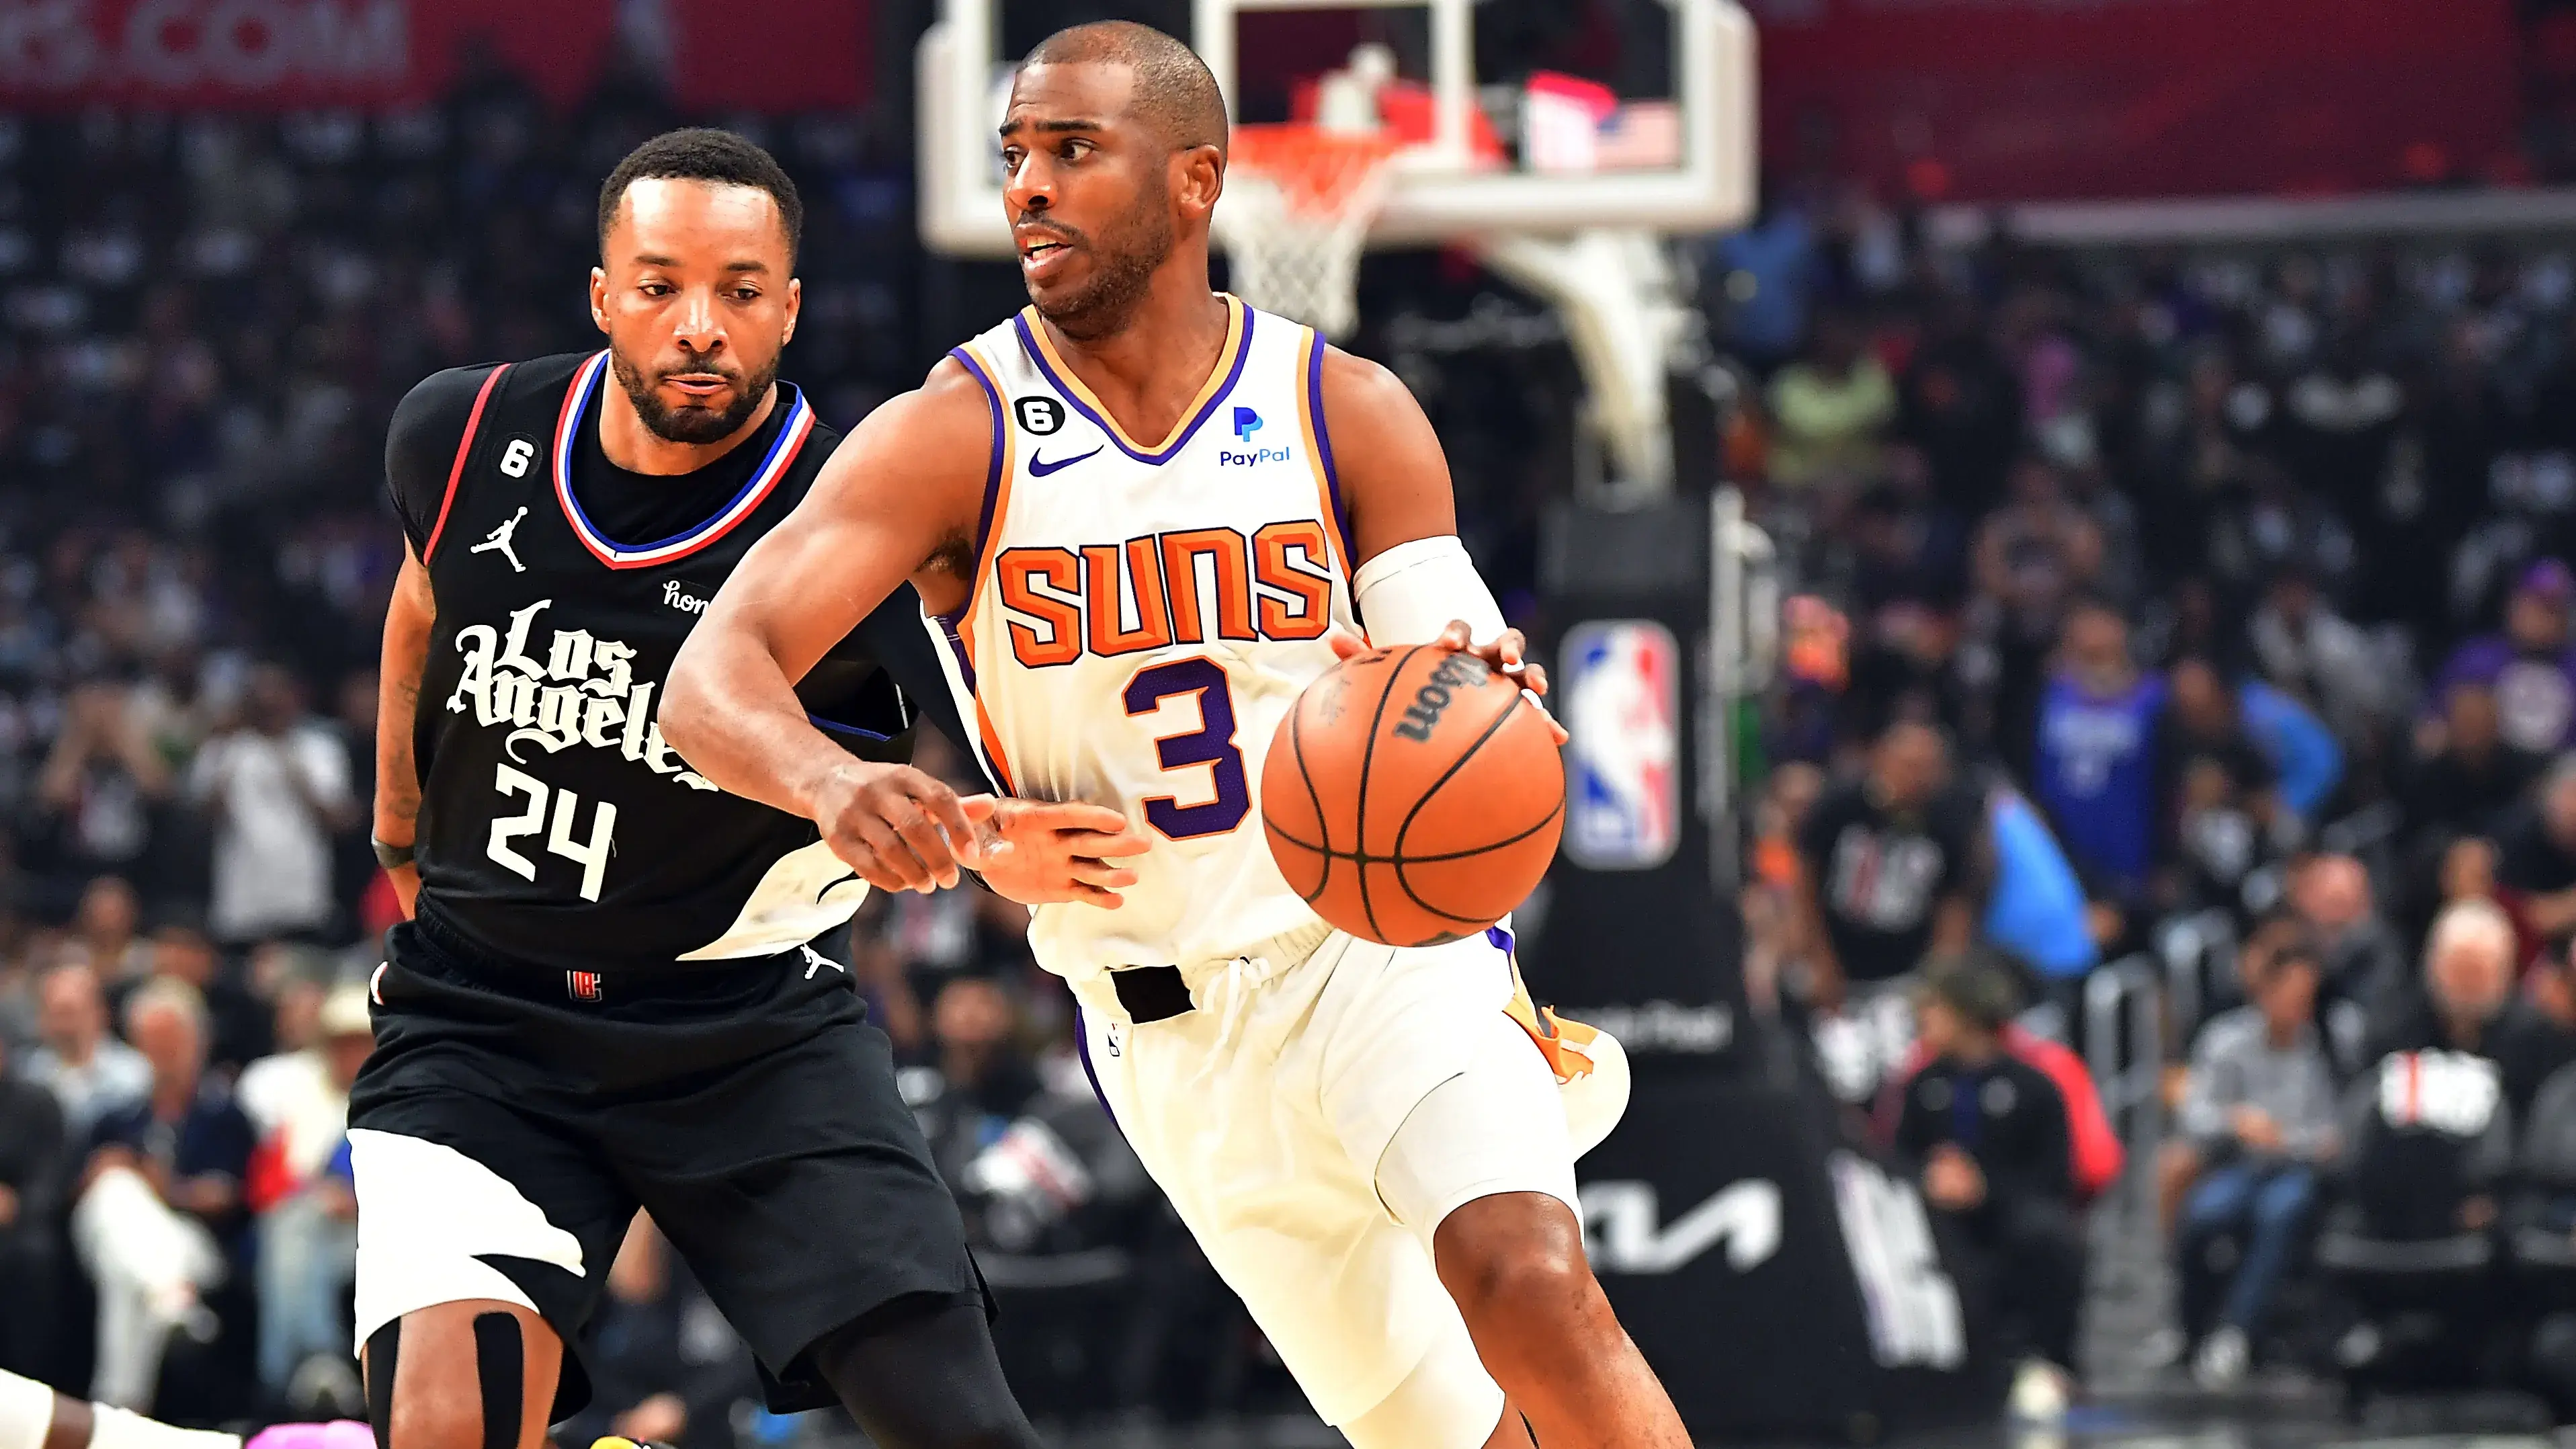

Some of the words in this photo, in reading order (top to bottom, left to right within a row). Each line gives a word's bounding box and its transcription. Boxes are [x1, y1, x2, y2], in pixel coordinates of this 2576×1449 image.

[0, 0, 408, 84] S.COM
[1023, 401, 1054, 431] 6
[1220, 446, 1290, 467] PayPal
[499, 439, 534, 478] 6
[663, 580, 710, 616] hon
[995, 519, 1333, 669] SUNS
[493, 599, 637, 698] Los
[1121, 655, 1253, 841] 3
[486, 762, 617, 903] 24
